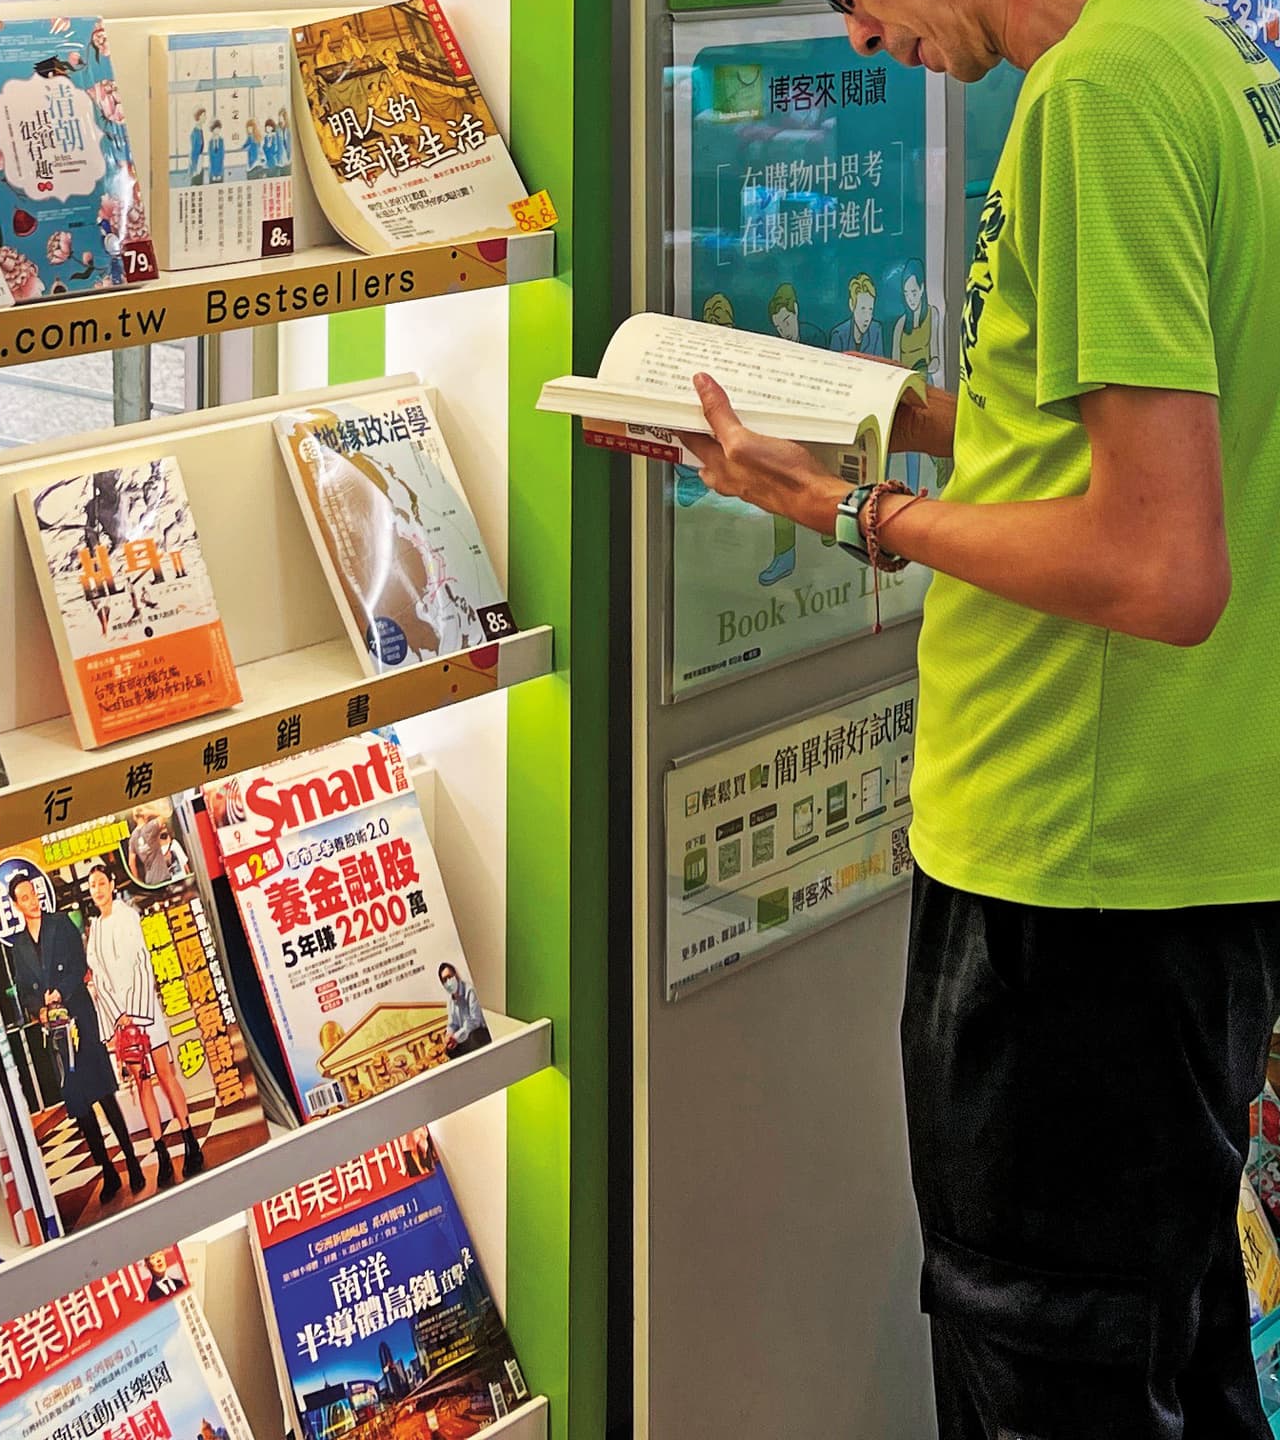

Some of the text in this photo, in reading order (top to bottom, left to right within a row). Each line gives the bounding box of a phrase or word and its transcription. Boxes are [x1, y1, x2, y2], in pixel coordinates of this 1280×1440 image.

[45, 83, 85, 154] 清朝
[327, 93, 420, 145] 明人的
[768, 66, 887, 114] 博客來閱讀
[342, 112, 488, 186] 率性生活
[740, 149, 883, 207] 在購物中思考
[741, 197, 884, 259] 在閱讀中進化
[207, 266, 415, 321] Bestsellers
[718, 596, 785, 645] Book
[792, 574, 852, 618] Your
[774, 698, 915, 791] 簡單掃好試閱
[245, 742, 396, 838] Smart
[701, 772, 747, 811] 輕鬆買
[264, 837, 420, 937] 養金融股
[792, 875, 834, 914] 博客來
[281, 889, 429, 970] 5年賺2200萬
[328, 1251, 391, 1310] 南洋
